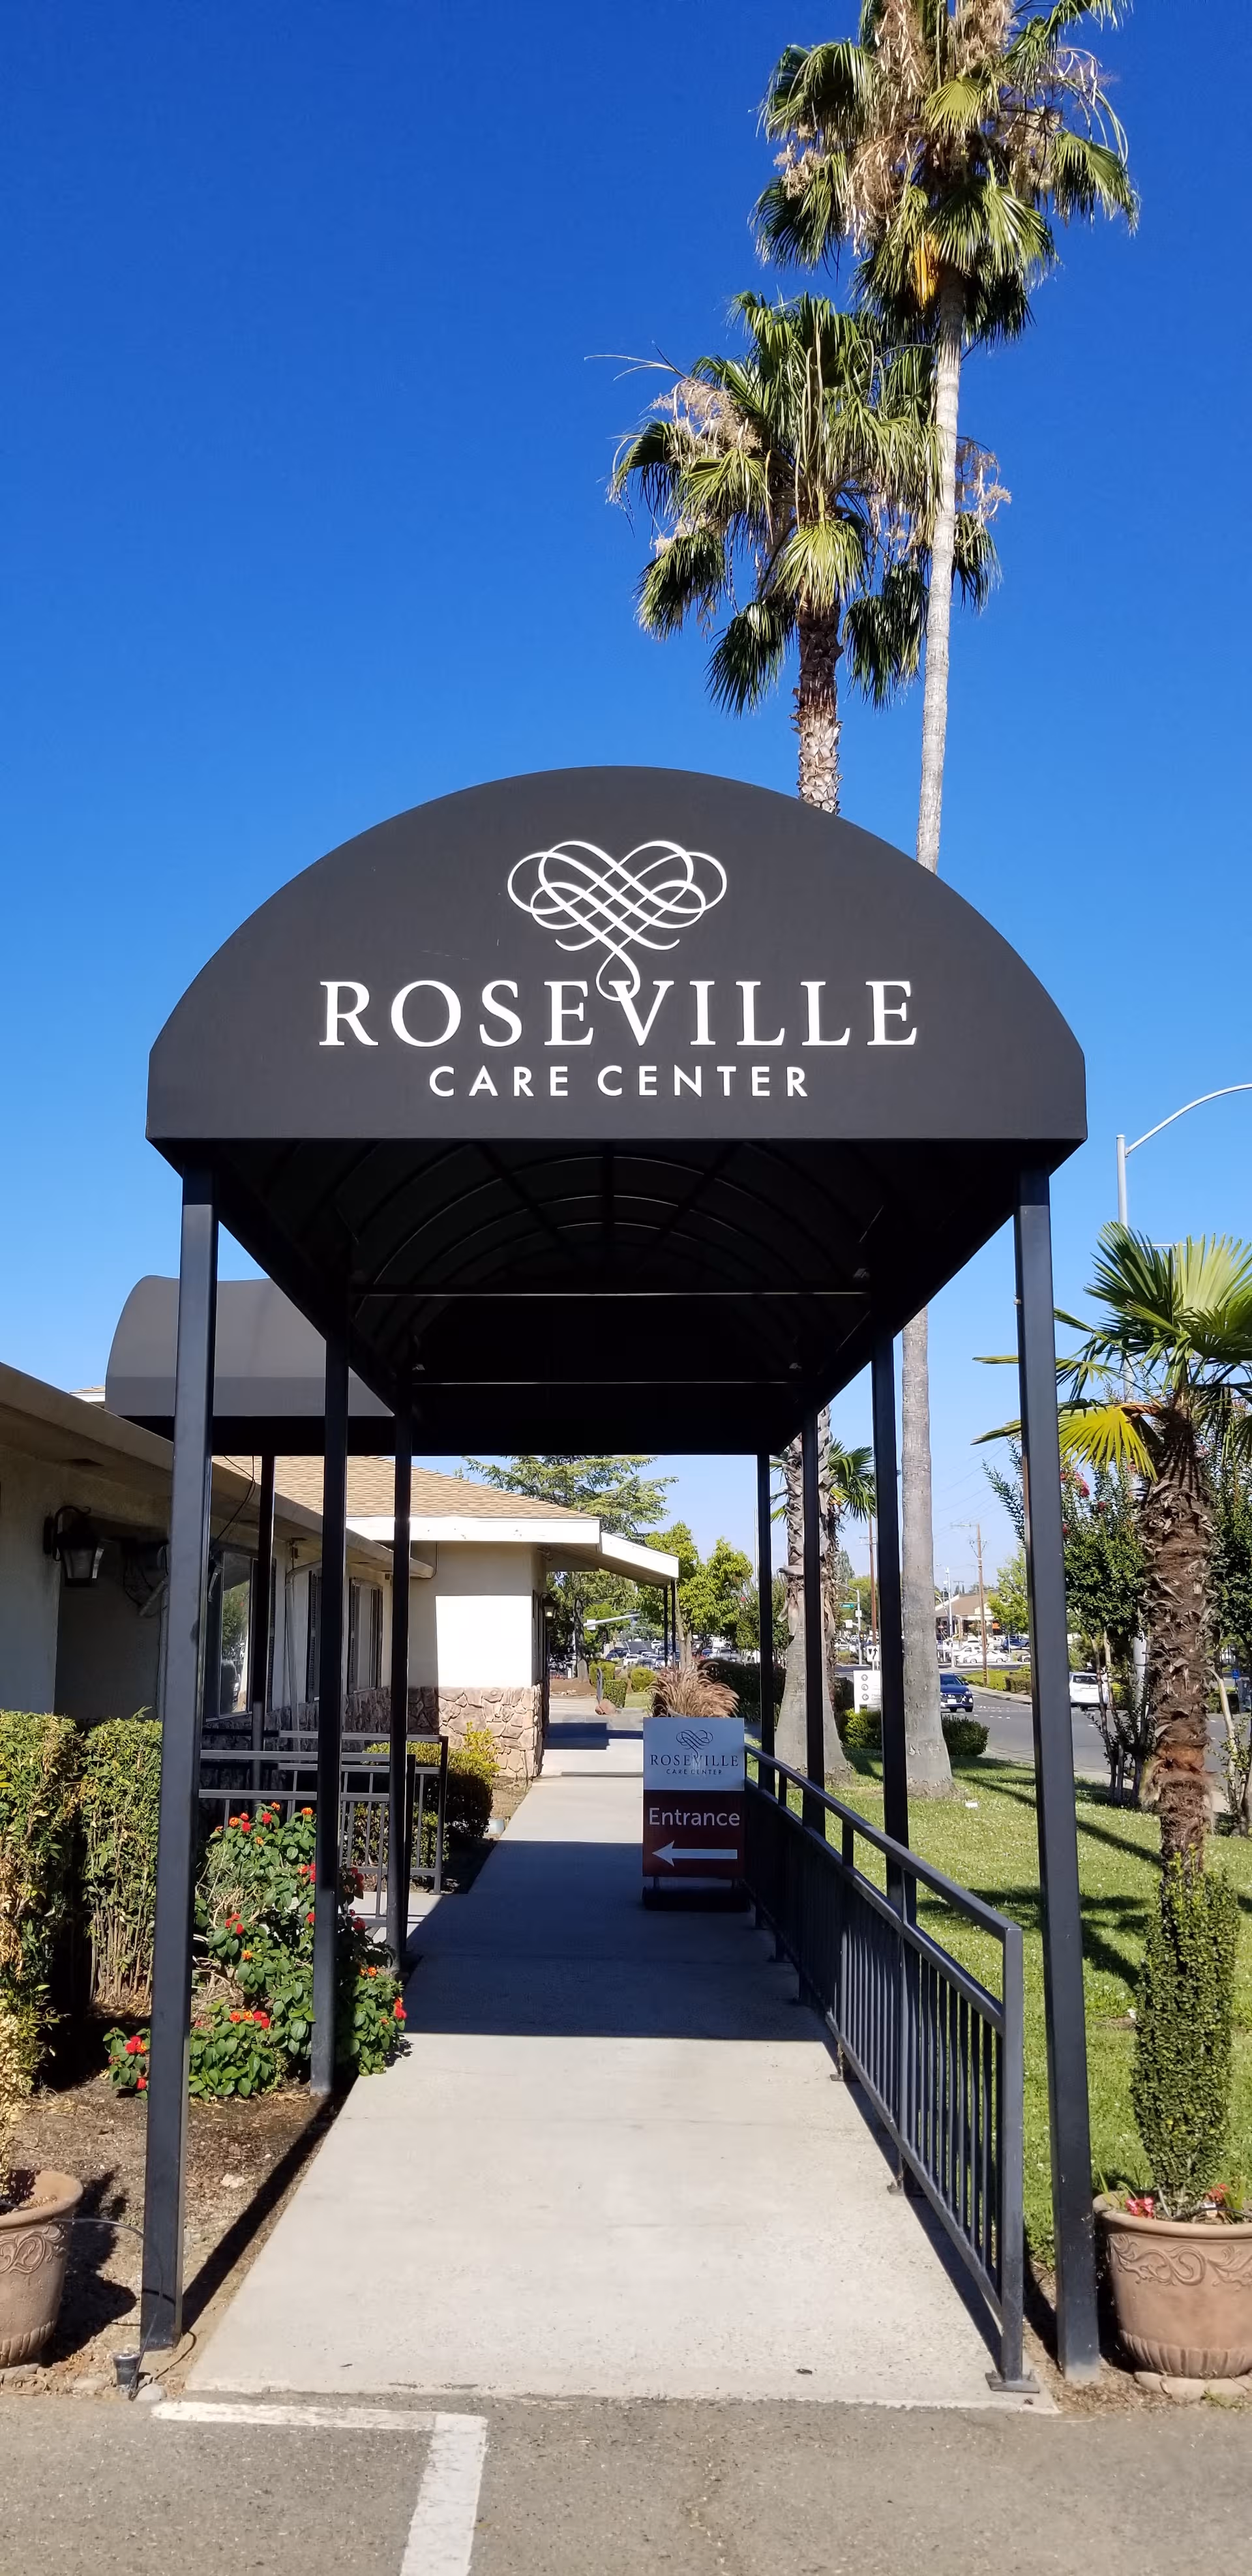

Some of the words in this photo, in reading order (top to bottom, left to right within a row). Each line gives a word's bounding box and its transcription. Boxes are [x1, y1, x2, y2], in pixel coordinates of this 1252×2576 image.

[320, 980, 917, 1047] ROSEVILLE
[430, 1066, 567, 1096] CARE
[598, 1065, 807, 1097] CENTER
[651, 1754, 738, 1767] ROSEVILLE
[649, 1808, 740, 1826] Entrance
